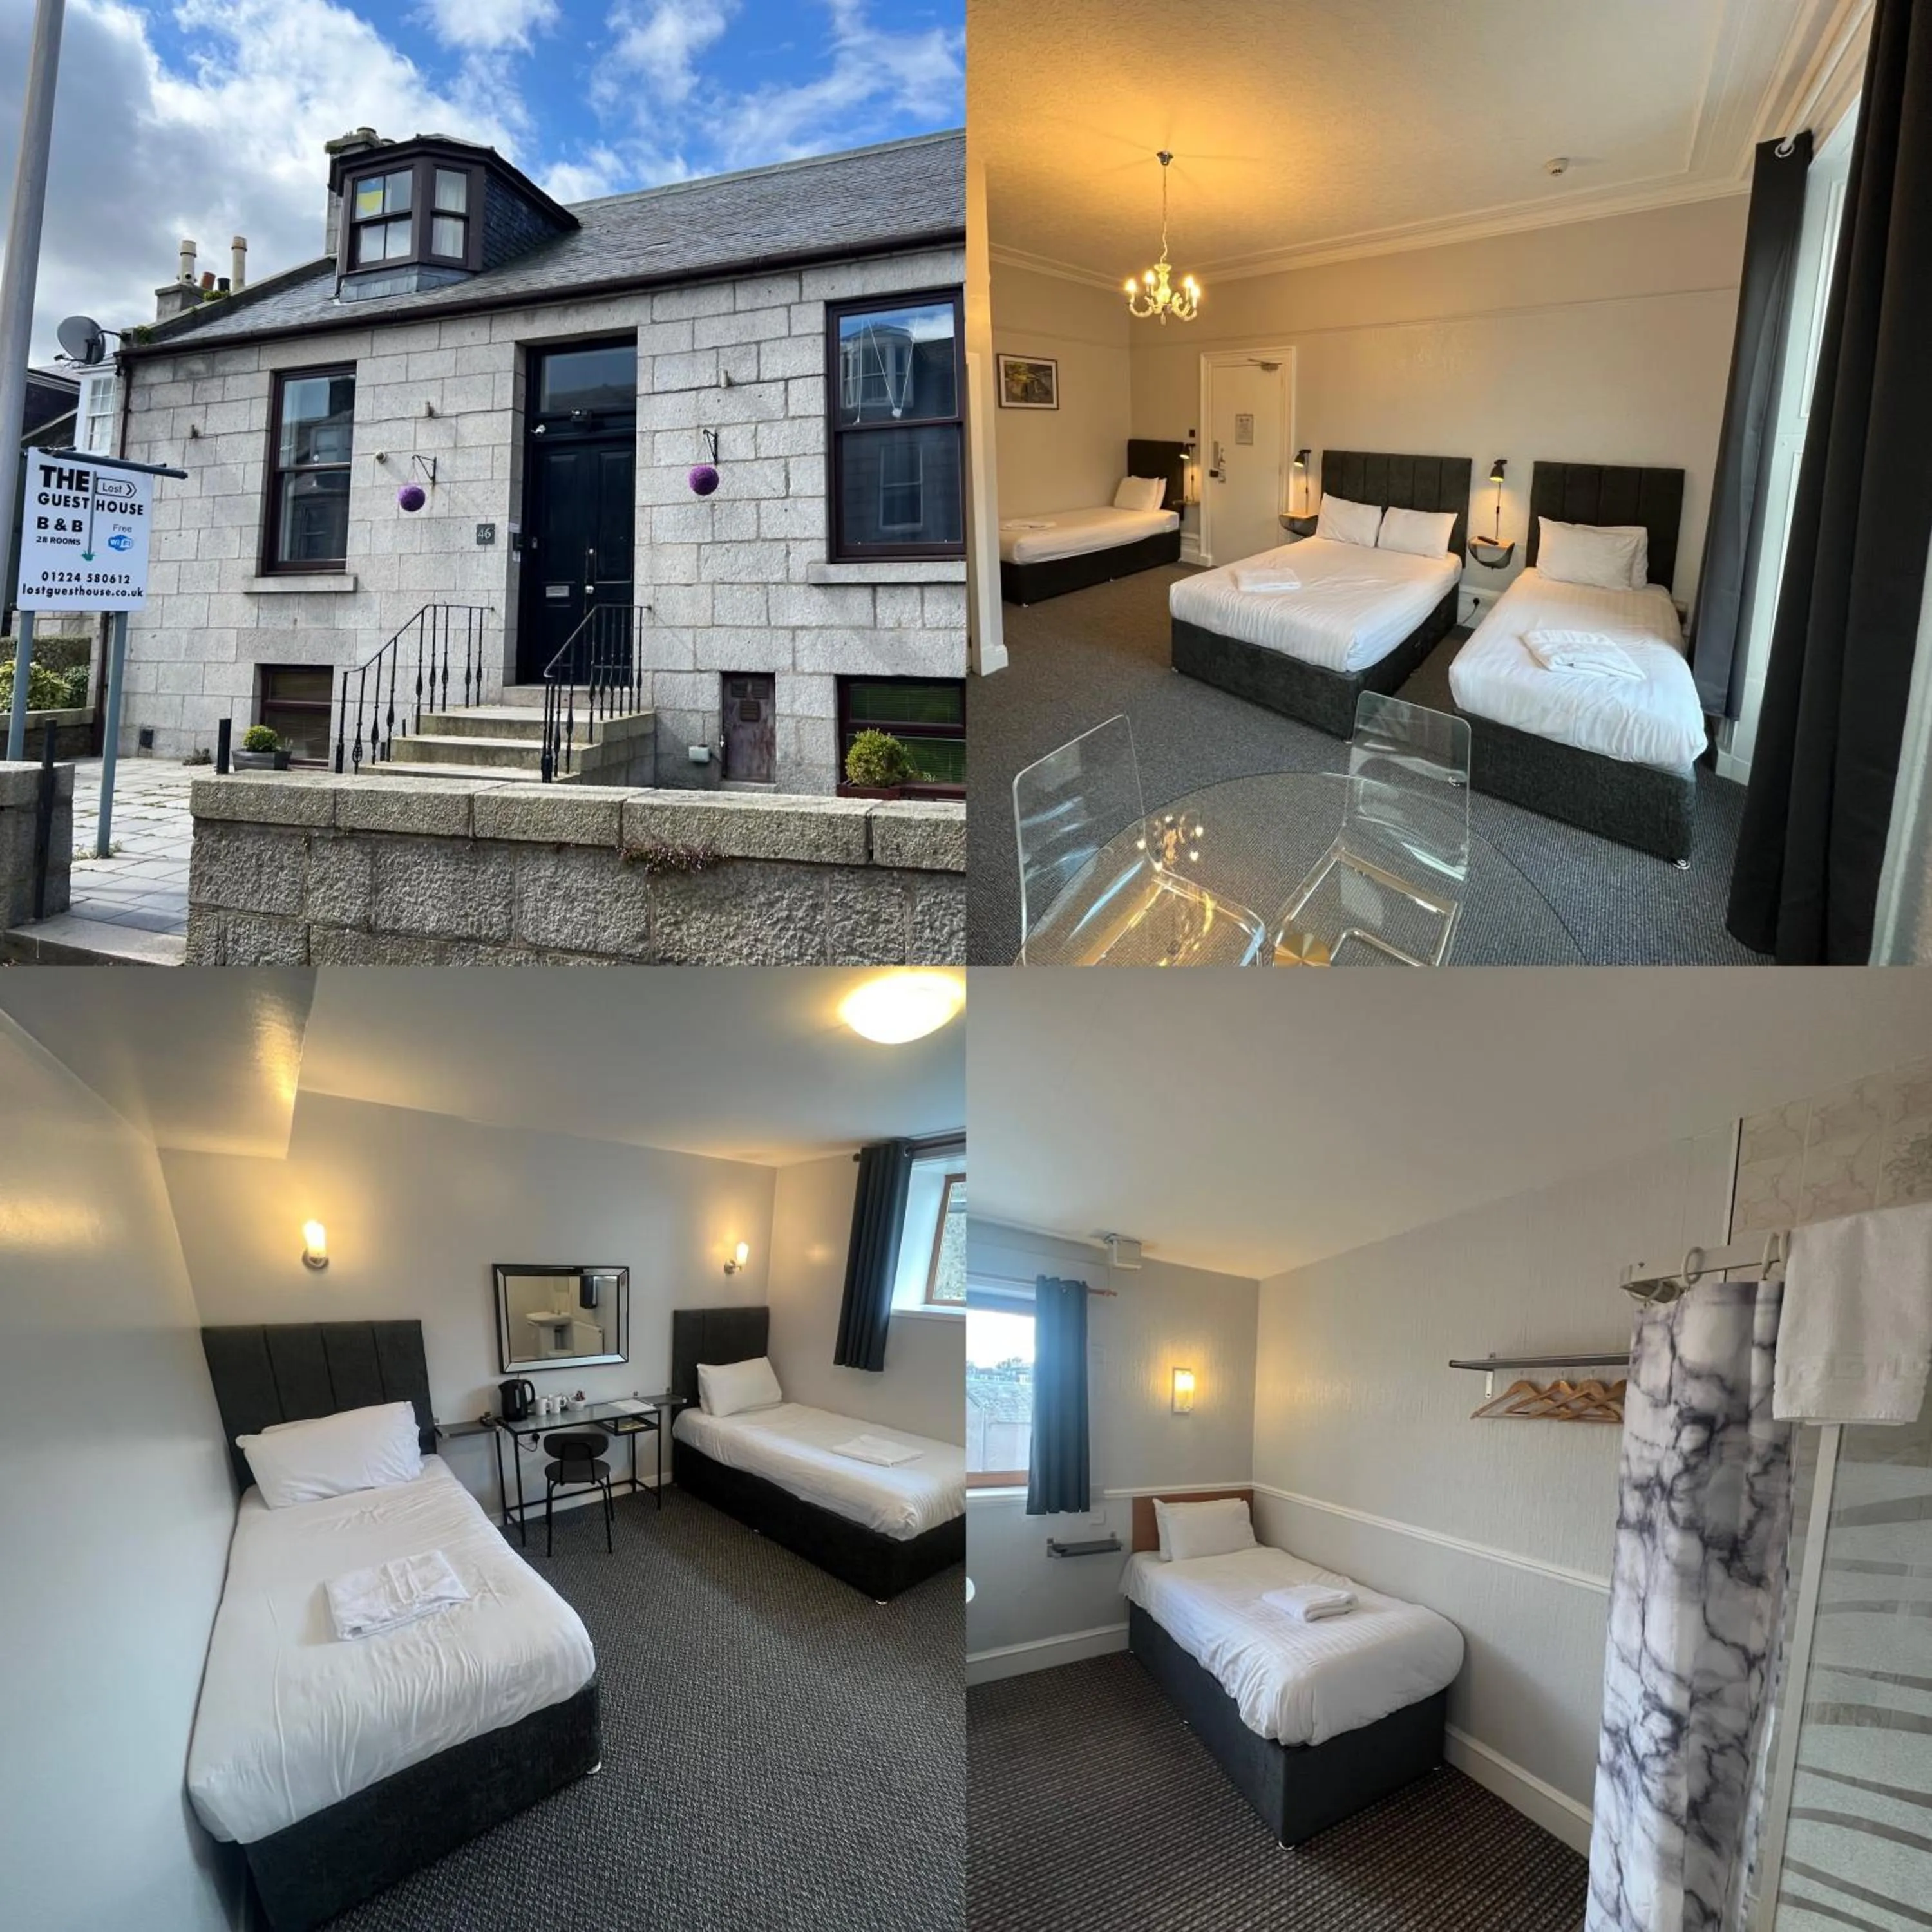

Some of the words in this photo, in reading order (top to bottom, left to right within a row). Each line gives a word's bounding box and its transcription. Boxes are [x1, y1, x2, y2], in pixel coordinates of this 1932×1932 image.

[39, 464, 90, 493] THE
[102, 482, 122, 493] Lost
[38, 492, 90, 509] GUEST
[96, 500, 144, 515] HOUSE
[37, 516, 48, 529] B
[54, 518, 67, 531] &
[71, 520, 83, 532] B
[113, 524, 132, 533] Free
[478, 527, 491, 539] 46
[50, 536, 80, 545] ROOMS
[41, 571, 81, 582] 01224
[86, 573, 130, 584] 580612
[22, 584, 144, 598] lostguesthouse.co.uk
